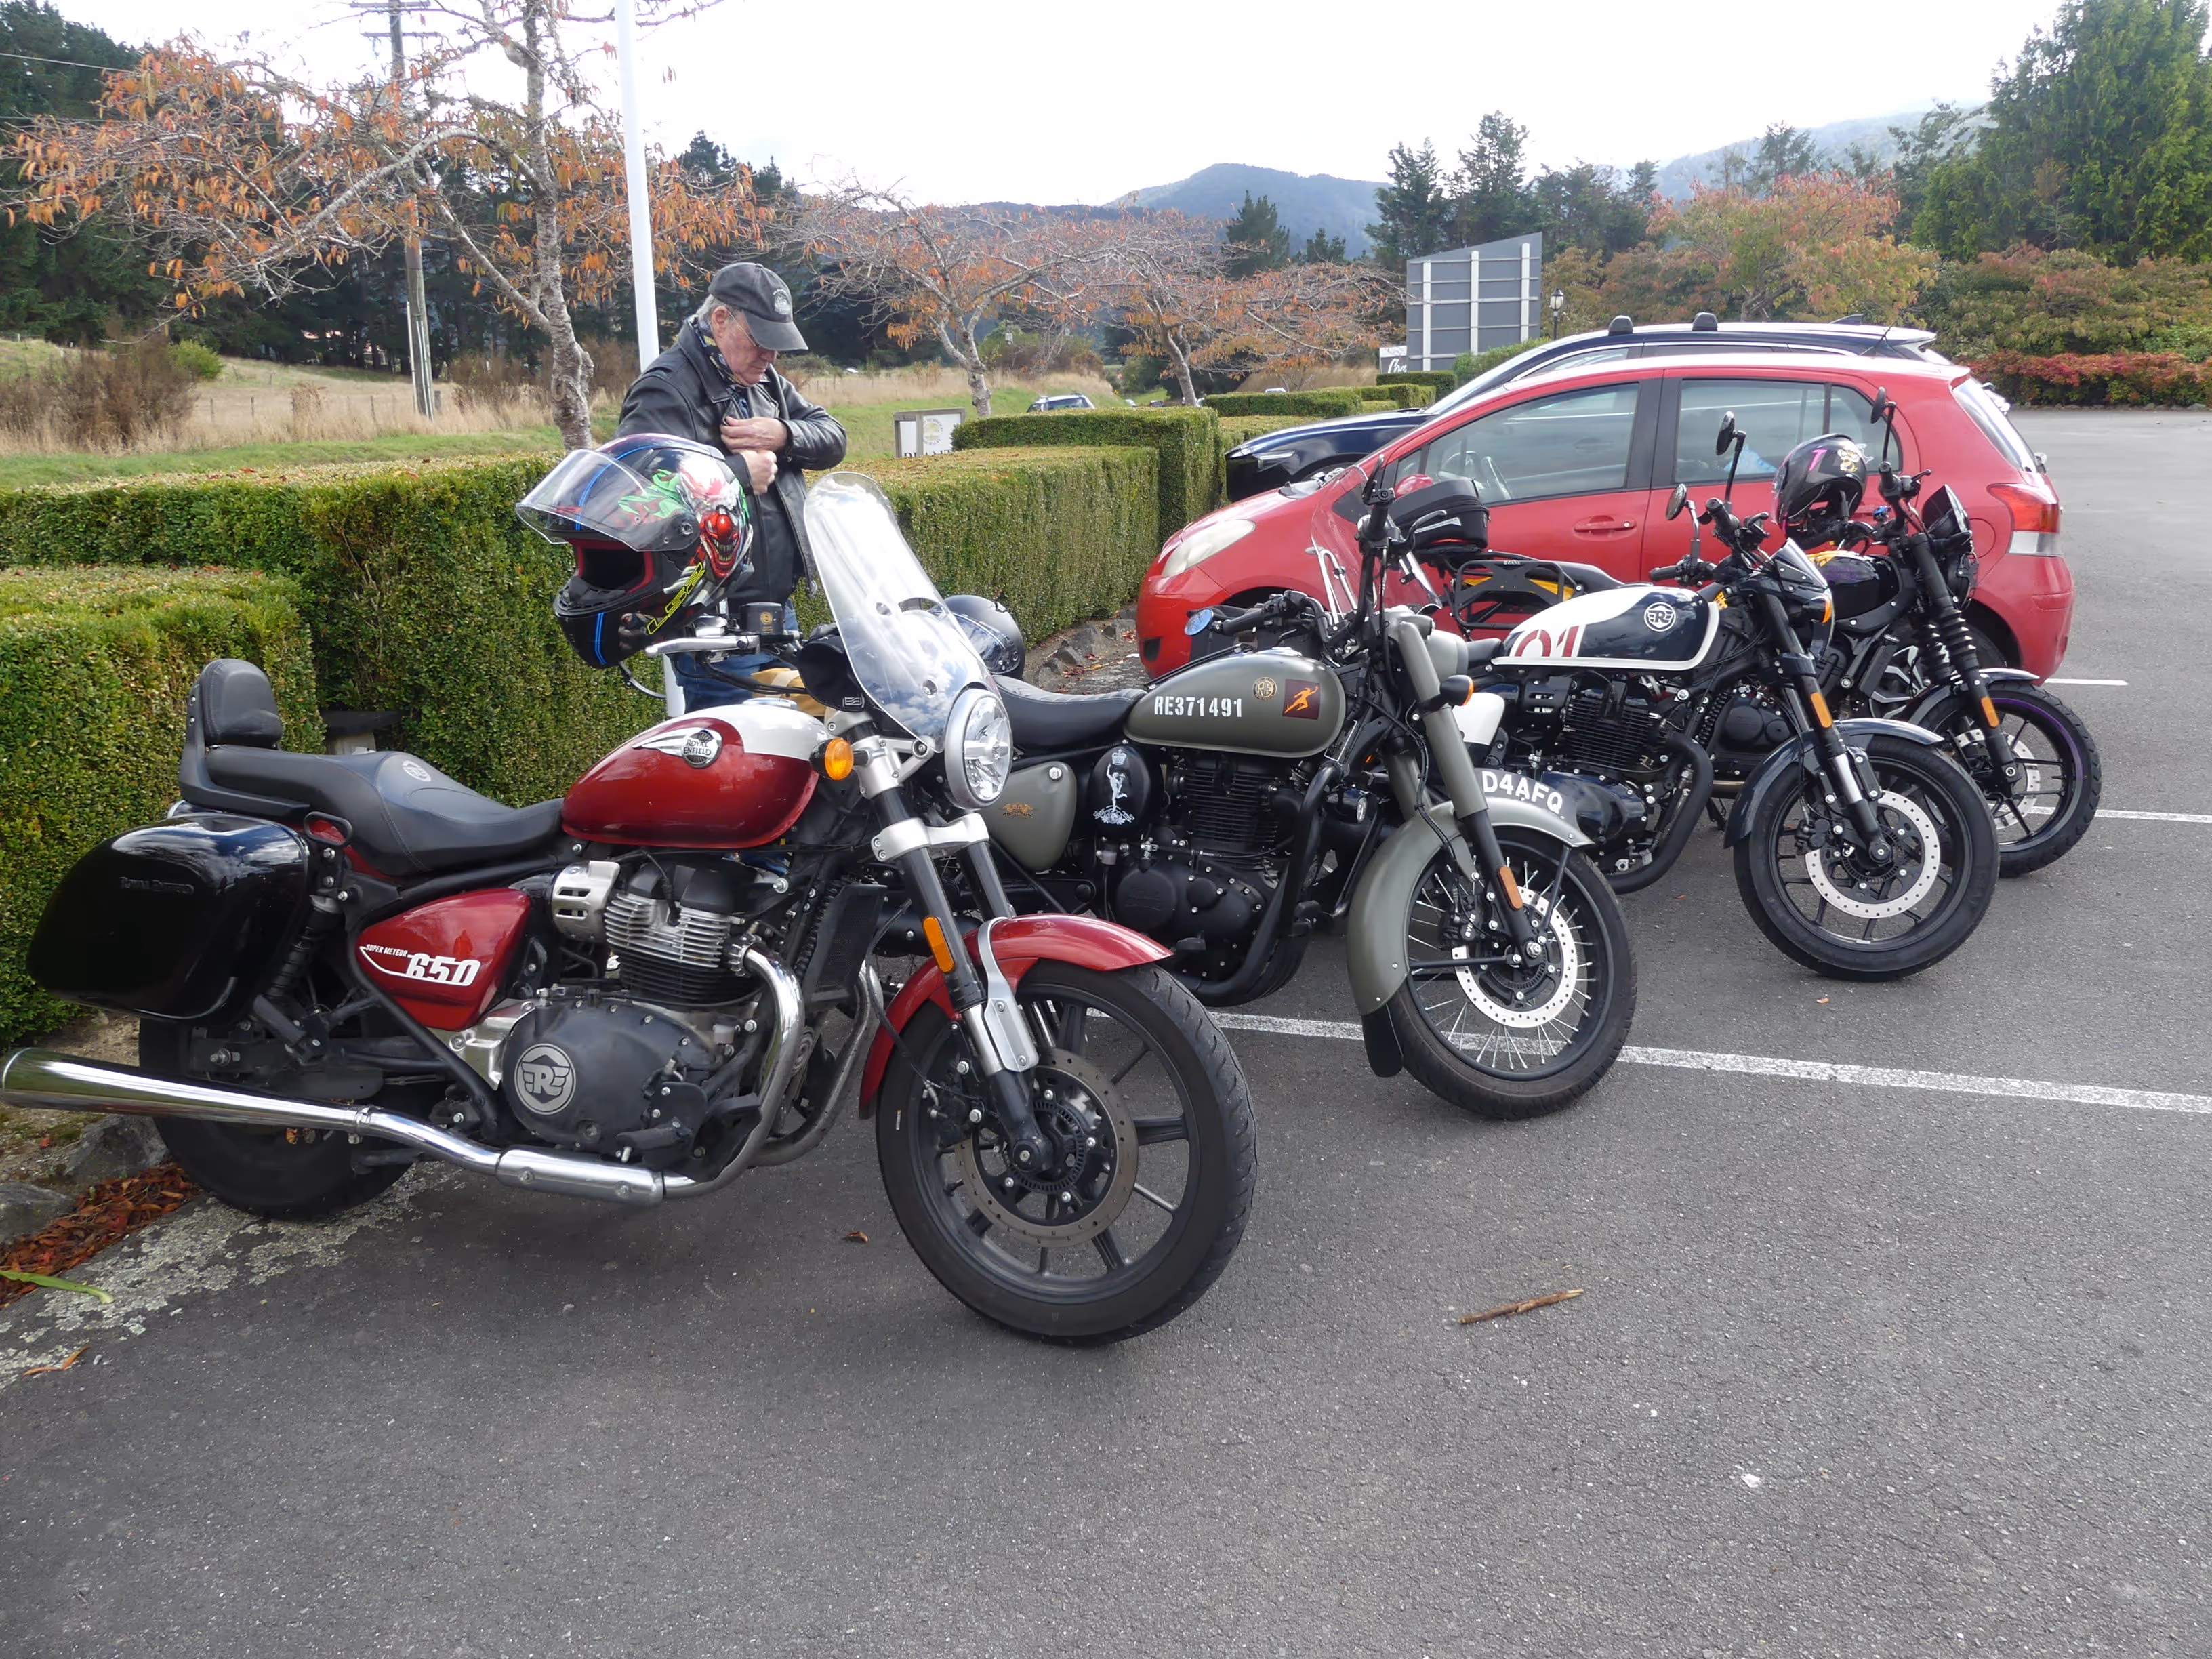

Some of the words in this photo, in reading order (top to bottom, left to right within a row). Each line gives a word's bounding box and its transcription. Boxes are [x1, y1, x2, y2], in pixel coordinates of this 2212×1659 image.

[686, 739, 708, 747] ROYAL
[683, 747, 712, 756] ENFIELD
[1481, 771, 1563, 814] D4AFQ
[365, 943, 384, 954] SUPER
[384, 947, 409, 958] METEOR
[406, 953, 481, 987] 650
